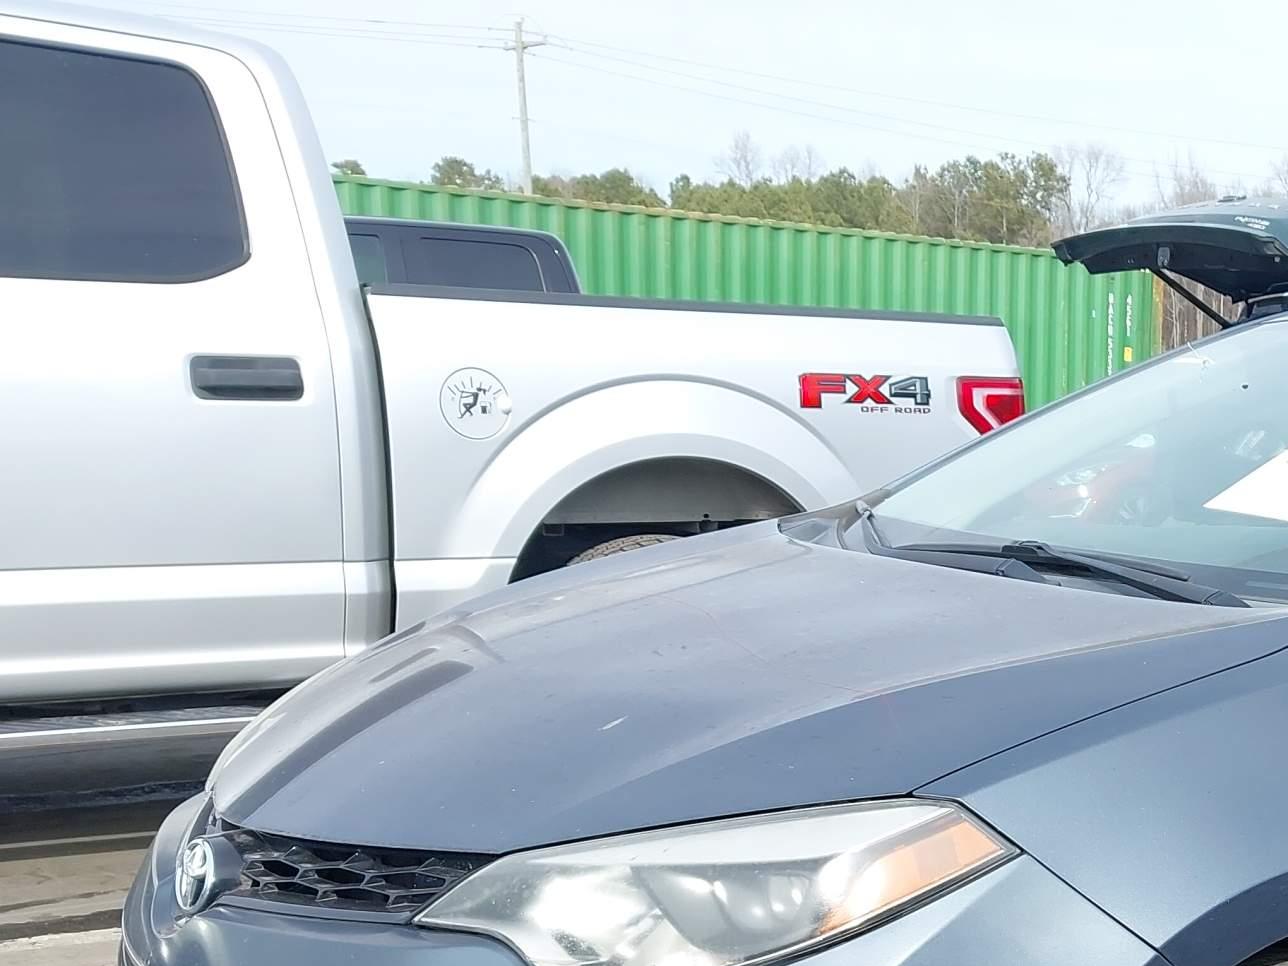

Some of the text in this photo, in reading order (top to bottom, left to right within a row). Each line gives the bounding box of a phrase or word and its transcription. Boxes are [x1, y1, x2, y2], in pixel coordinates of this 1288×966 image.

[799, 372, 932, 409] FX4
[860, 406, 932, 415] OFF ROAD
